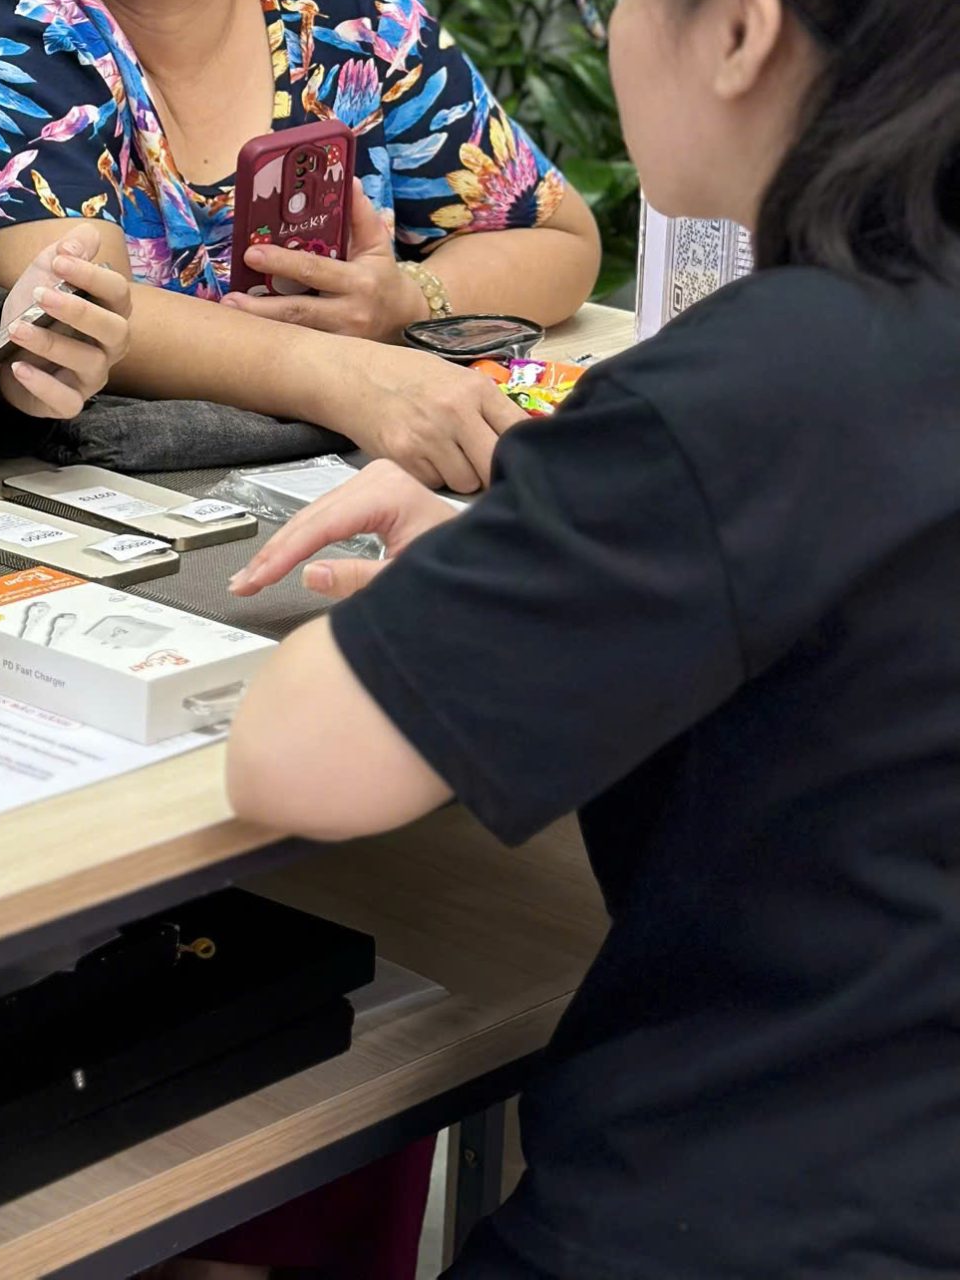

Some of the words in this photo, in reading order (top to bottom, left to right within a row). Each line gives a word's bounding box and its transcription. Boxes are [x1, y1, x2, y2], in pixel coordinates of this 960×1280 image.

[279, 214, 328, 234] LUCKY
[15, 663, 32, 677] Fast
[34, 670, 66, 688] Charger
